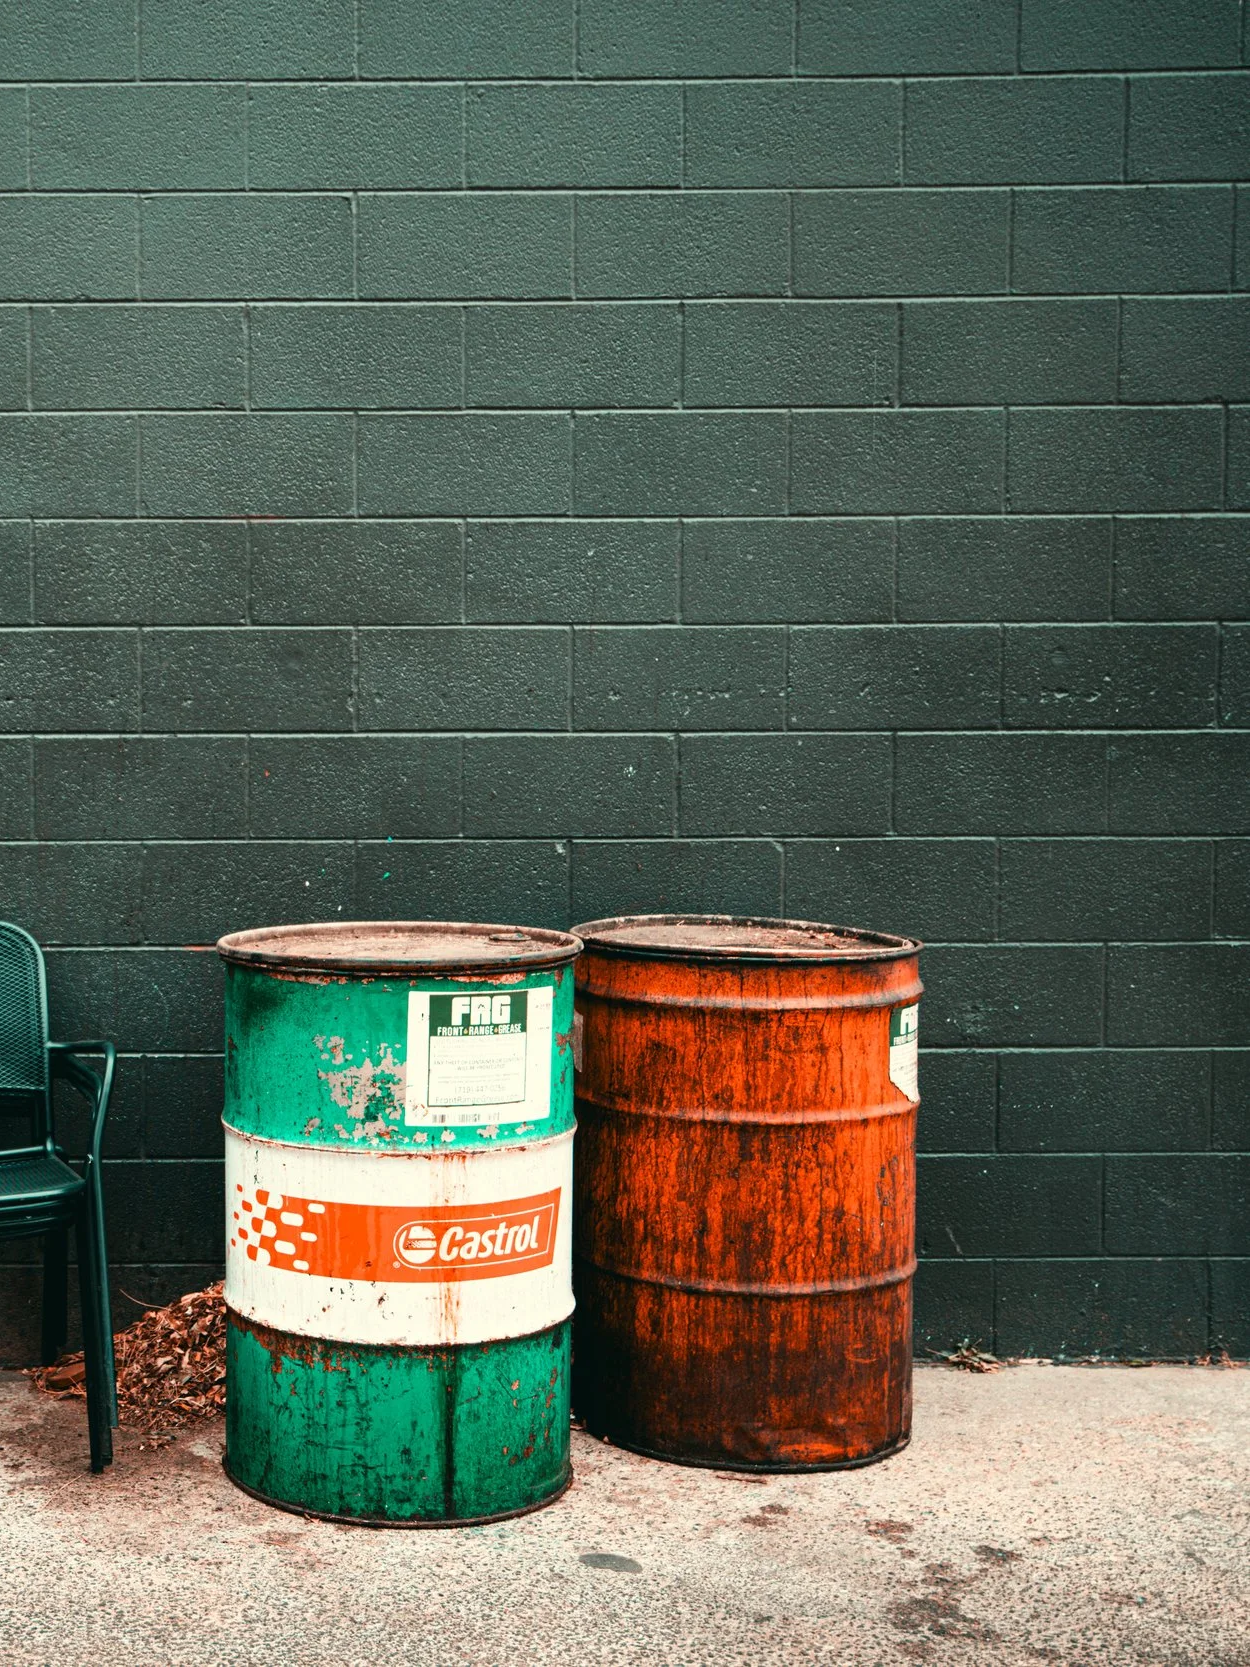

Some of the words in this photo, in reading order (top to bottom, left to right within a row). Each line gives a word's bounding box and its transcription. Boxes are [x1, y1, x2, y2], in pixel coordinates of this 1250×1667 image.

[451, 995, 511, 1026] FRG
[437, 1026, 464, 1036] FRONT
[468, 1025, 494, 1035] RANGE
[498, 1023, 522, 1034] GREASE
[439, 1214, 540, 1262] Castrol
